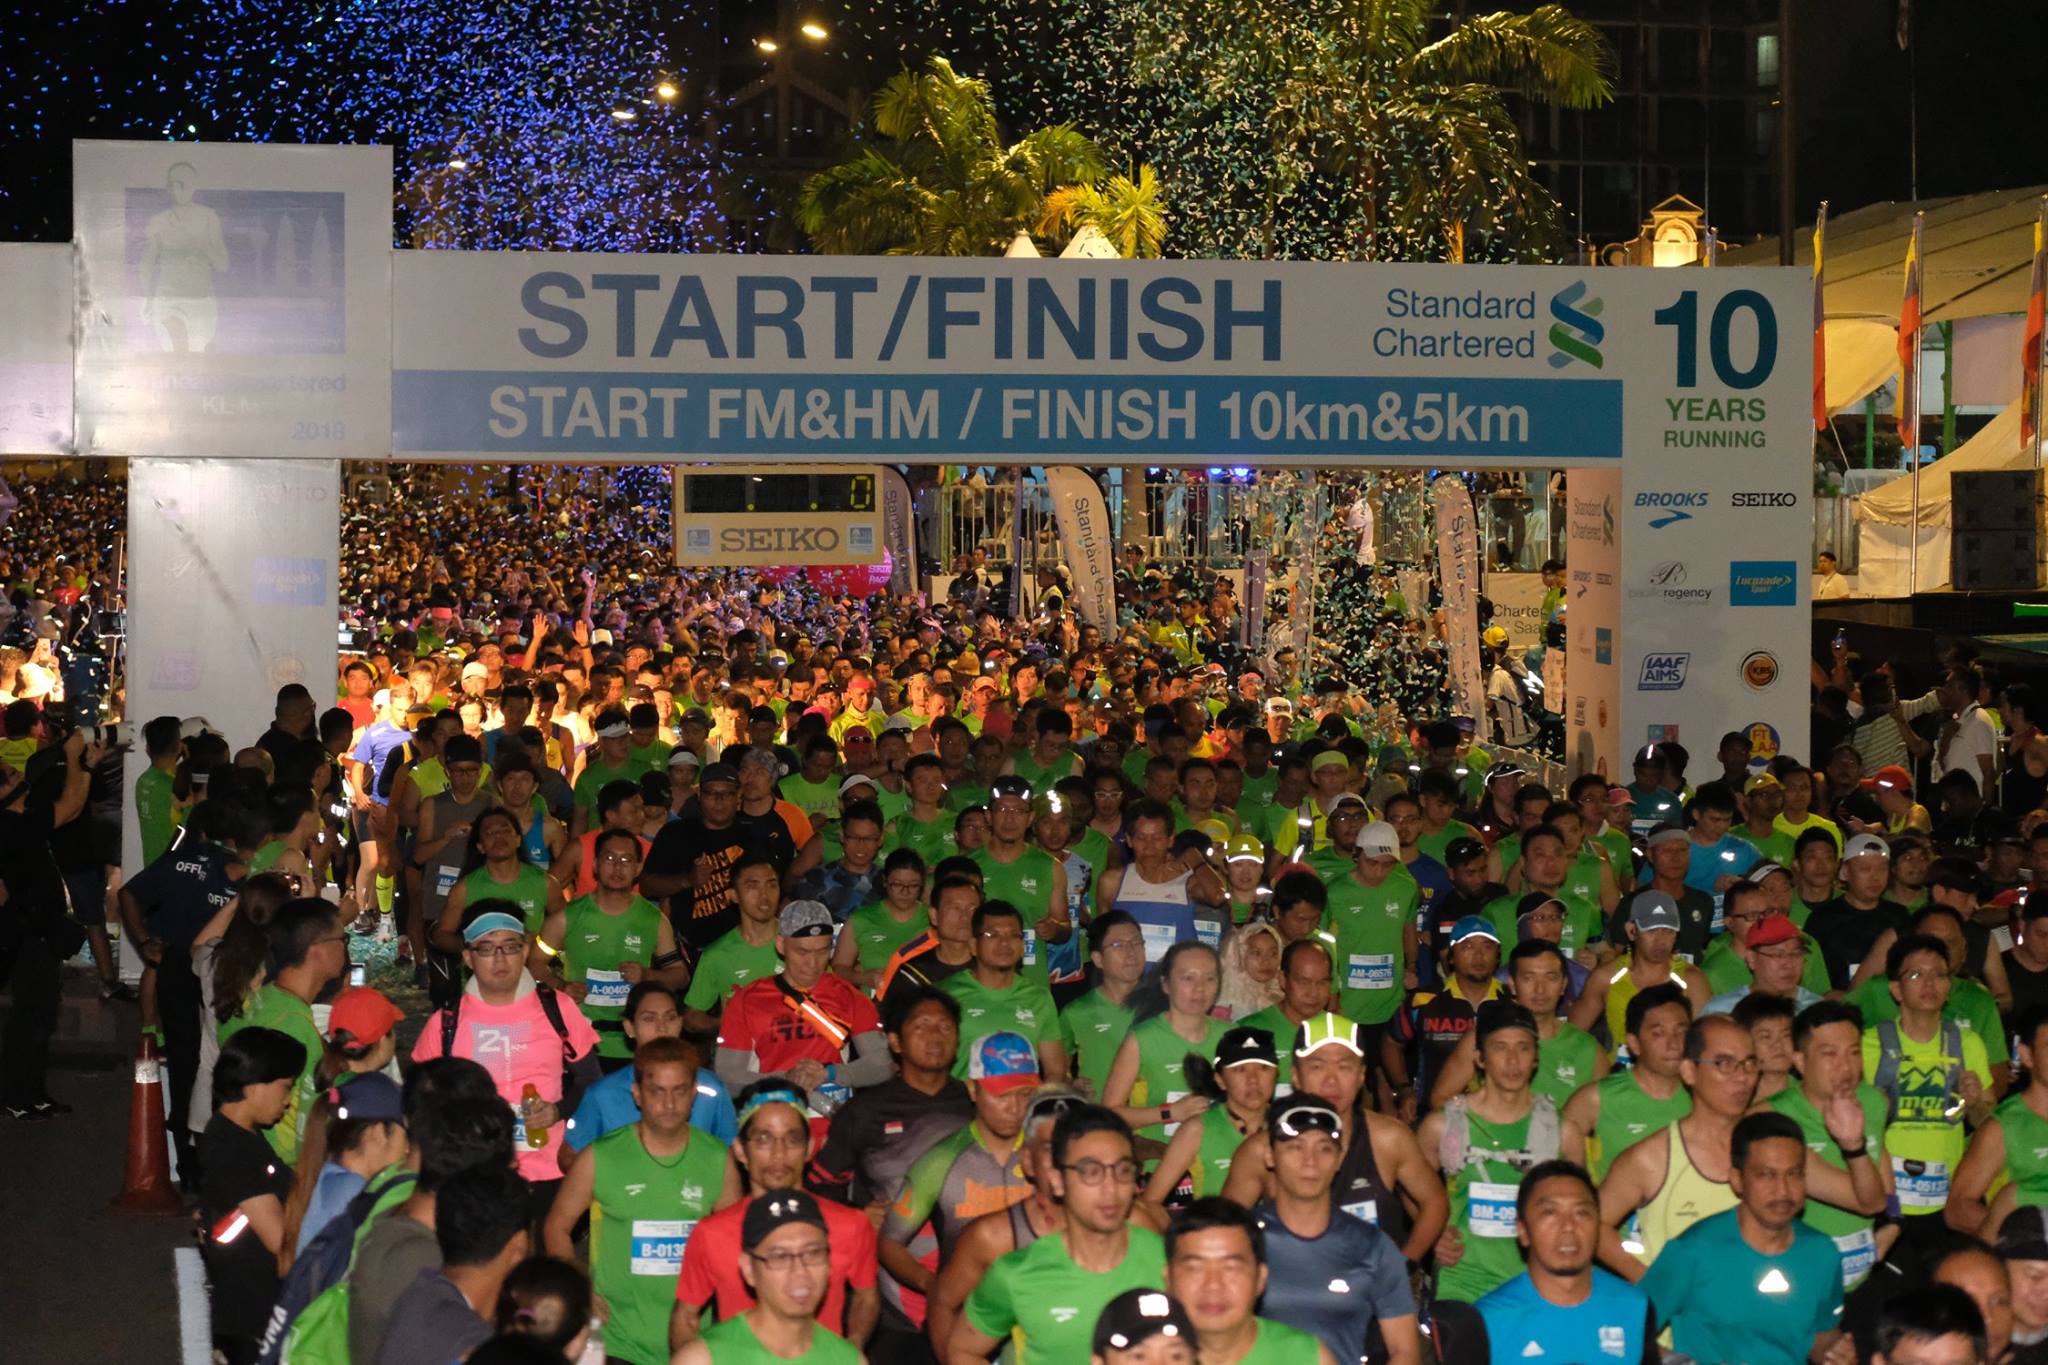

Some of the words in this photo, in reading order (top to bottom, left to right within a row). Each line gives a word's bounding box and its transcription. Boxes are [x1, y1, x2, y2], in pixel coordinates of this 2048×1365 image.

[1387, 288, 1536, 319] Standard
[518, 271, 1282, 362] START/FINISH
[1372, 328, 1536, 359] Chartered
[1655, 289, 1778, 390] 10
[488, 385, 688, 440] START
[708, 387, 940, 441] FM&HM
[958, 388, 984, 441] /
[1002, 389, 1197, 441] FINISH
[1219, 390, 1529, 443] 10km&5km
[1665, 398, 1767, 423] YEARS
[1663, 430, 1767, 449] RUNNING
[1633, 492, 1710, 507] BROOKS
[1731, 492, 1797, 507] SEIKO
[720, 527, 840, 552] SEIKO
[1075, 497, 1101, 576] Standard
[1645, 669, 1681, 681] AIMS
[1647, 656, 1686, 669] IAAF
